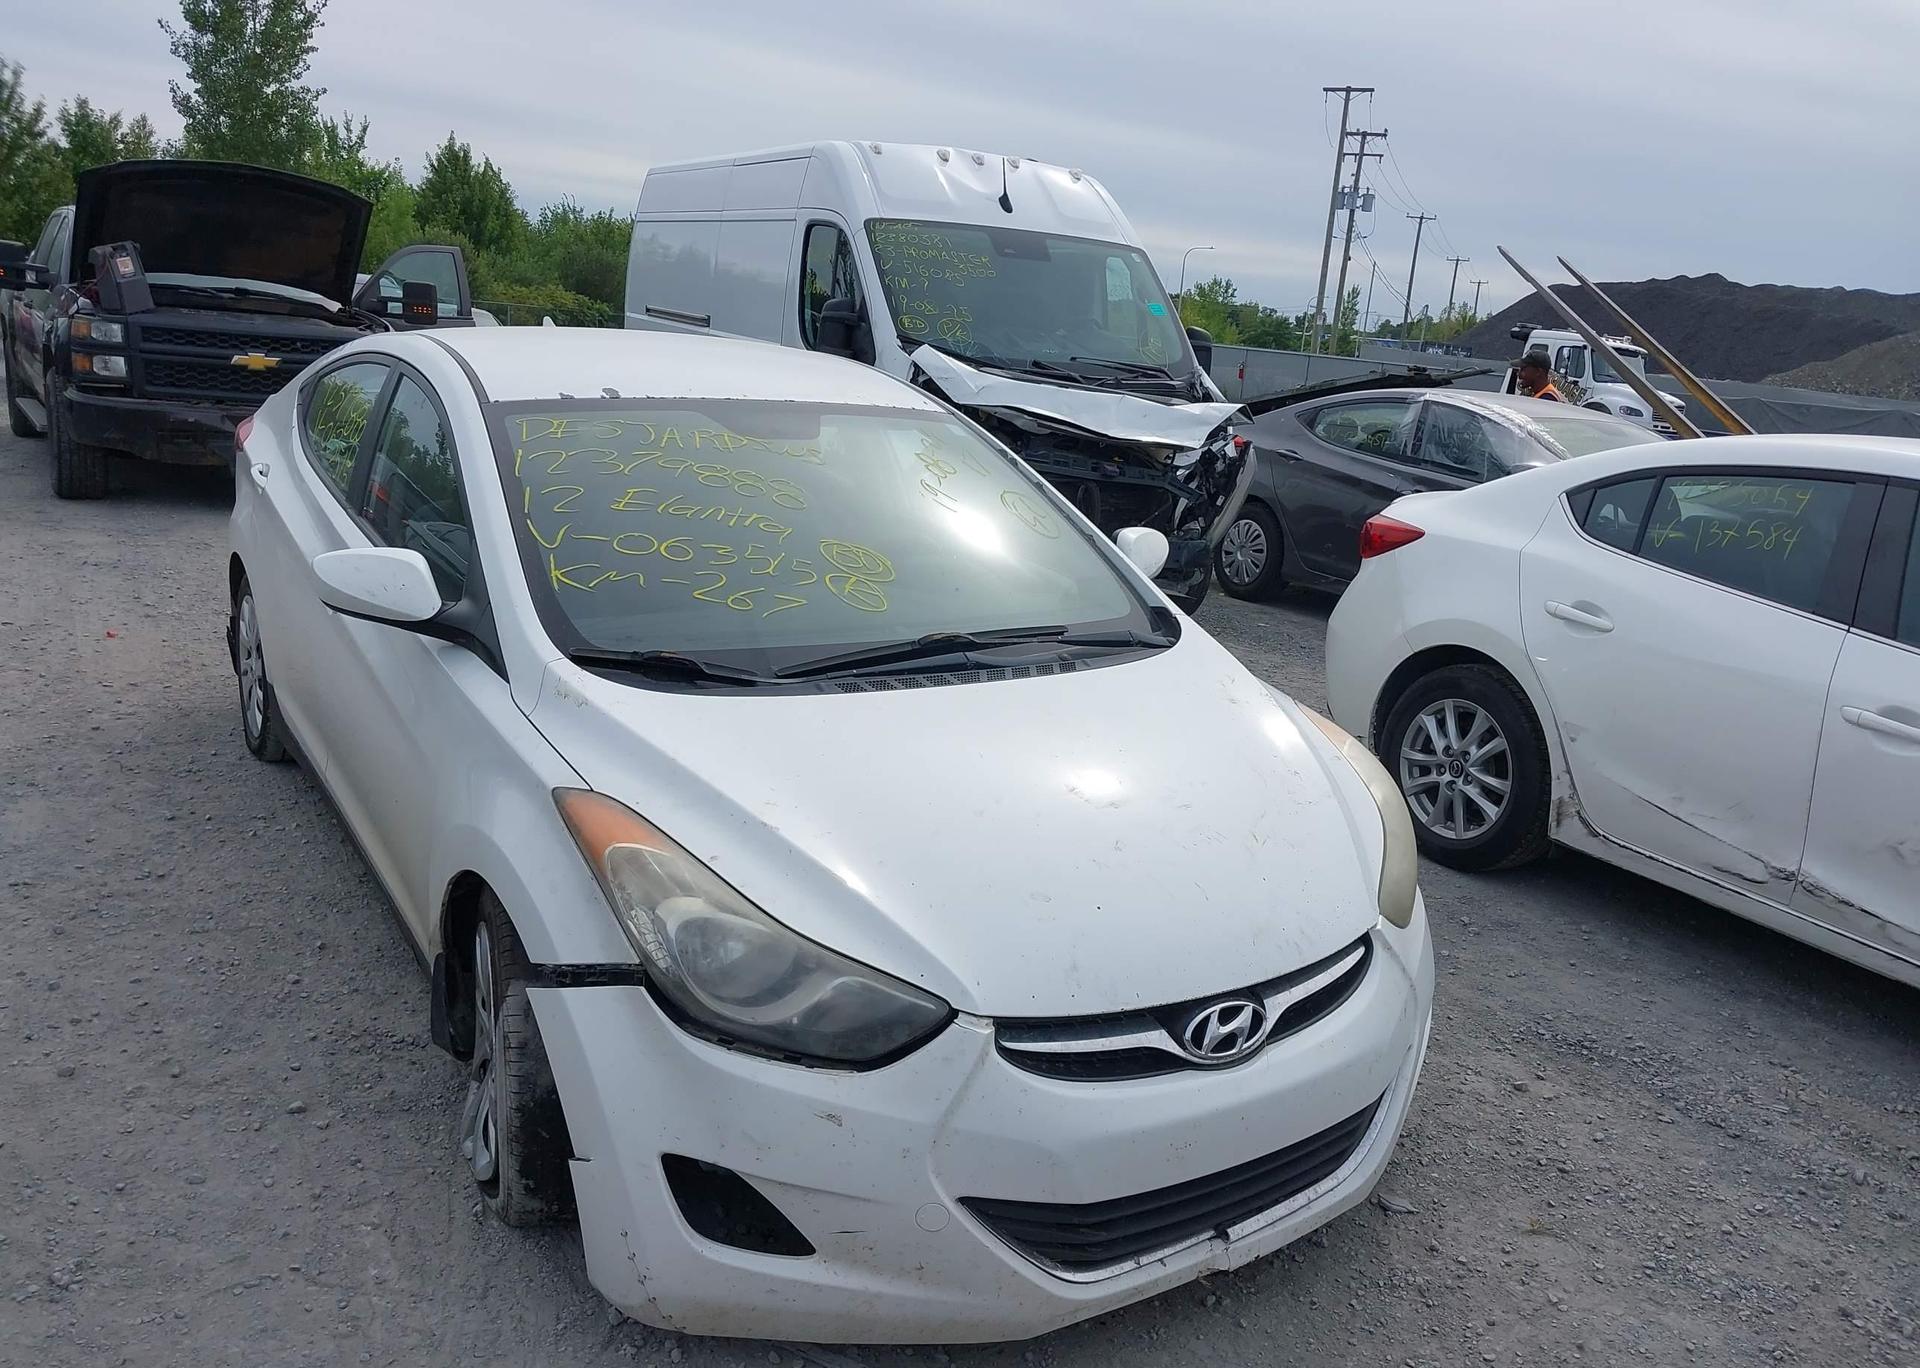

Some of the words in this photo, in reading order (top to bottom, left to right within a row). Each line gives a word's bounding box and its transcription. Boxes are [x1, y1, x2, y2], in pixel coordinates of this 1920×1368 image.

[515, 449, 809, 510] 12379888
[525, 486, 584, 514] 12
[610, 488, 794, 544] Elantra
